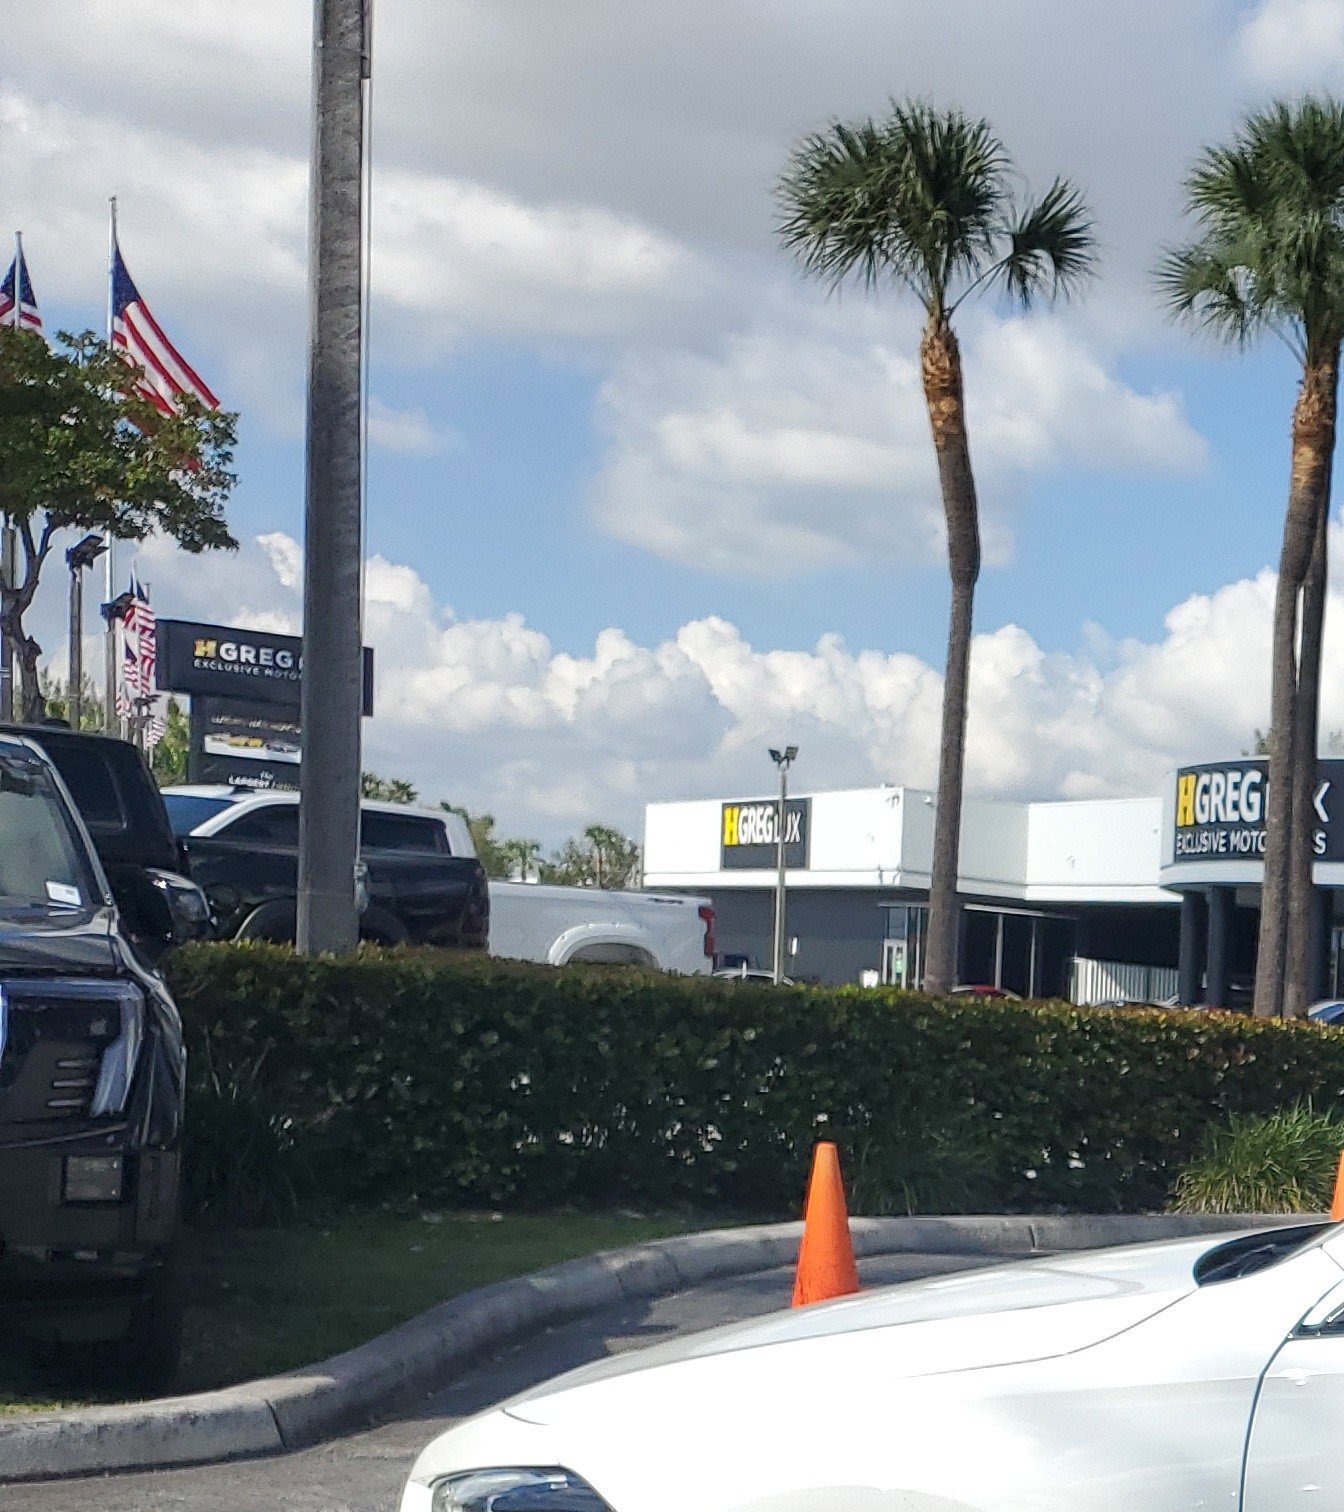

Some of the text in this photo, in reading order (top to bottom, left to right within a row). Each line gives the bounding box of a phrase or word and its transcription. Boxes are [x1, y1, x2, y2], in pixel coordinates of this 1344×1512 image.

[193, 658, 303, 681] EXCLUSIVE MOTO
[1176, 830, 1227, 855] EXCLUSIVE
